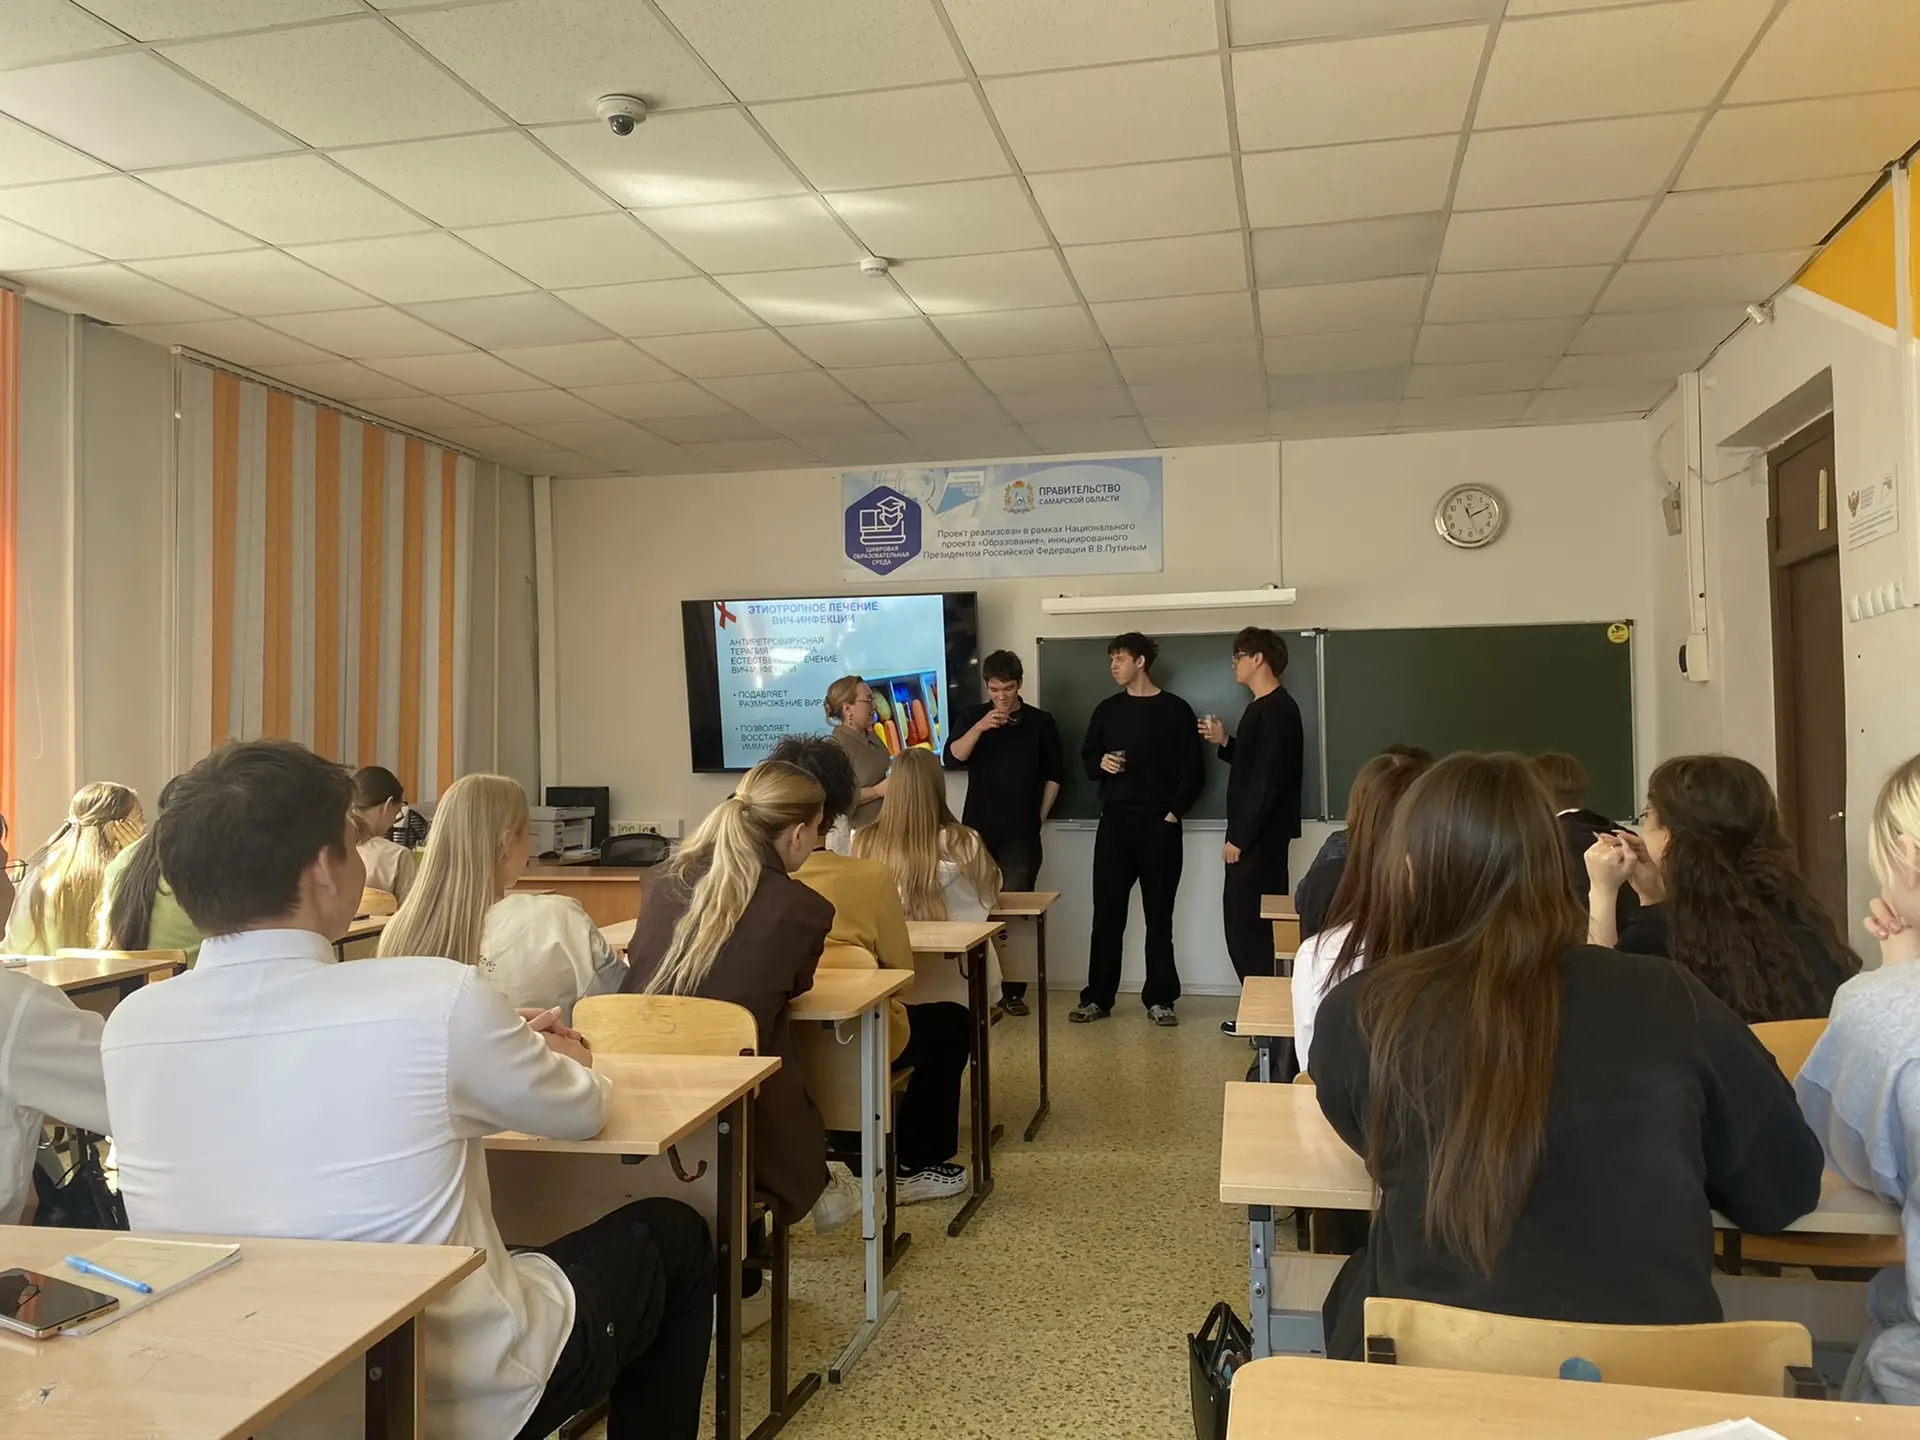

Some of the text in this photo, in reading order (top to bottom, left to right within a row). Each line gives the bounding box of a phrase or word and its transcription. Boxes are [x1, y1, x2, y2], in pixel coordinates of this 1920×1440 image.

[1038, 483, 1121, 496] ПРАВИТЕЛЬСТВО
[1038, 495, 1120, 505] САМАРСКОЙ ОБЛАСТИ
[937, 529, 968, 539] Проект
[970, 528, 1021, 538] реализован
[1030, 526, 1063, 535] рамках
[1065, 522, 1136, 534] Национального
[941, 534, 1128, 549] проекта «Образование», инициированного
[865, 545, 899, 553] ЦИФРОВАЯ
[923, 549, 981, 560] Президентом
[982, 547, 1035, 557] Российской
[1036, 546, 1086, 556] Федерации
[852, 551, 910, 559] ОБРАЗОВАТЕЛЬНАЯ
[871, 558, 892, 566] СРЕДА
[747, 601, 878, 615] ЭТИОТРОПНОЕ ЛЕЧЕНИЕ
[771, 613, 856, 625] ВИЧ-ИНФЕКЦИИ
[729, 636, 825, 647] АНТИРЕТРОВИРУСНАЯ
[730, 647, 769, 656] ТЕРАПИЯ
[801, 654, 838, 664] ЕЧЕНИЕ
[738, 690, 788, 699] ПОДАВЛЯЕТ
[738, 698, 803, 708] РАЗМНОЖЕНИЕ
[740, 724, 790, 733] ПОЗВОЛЯЕТ
